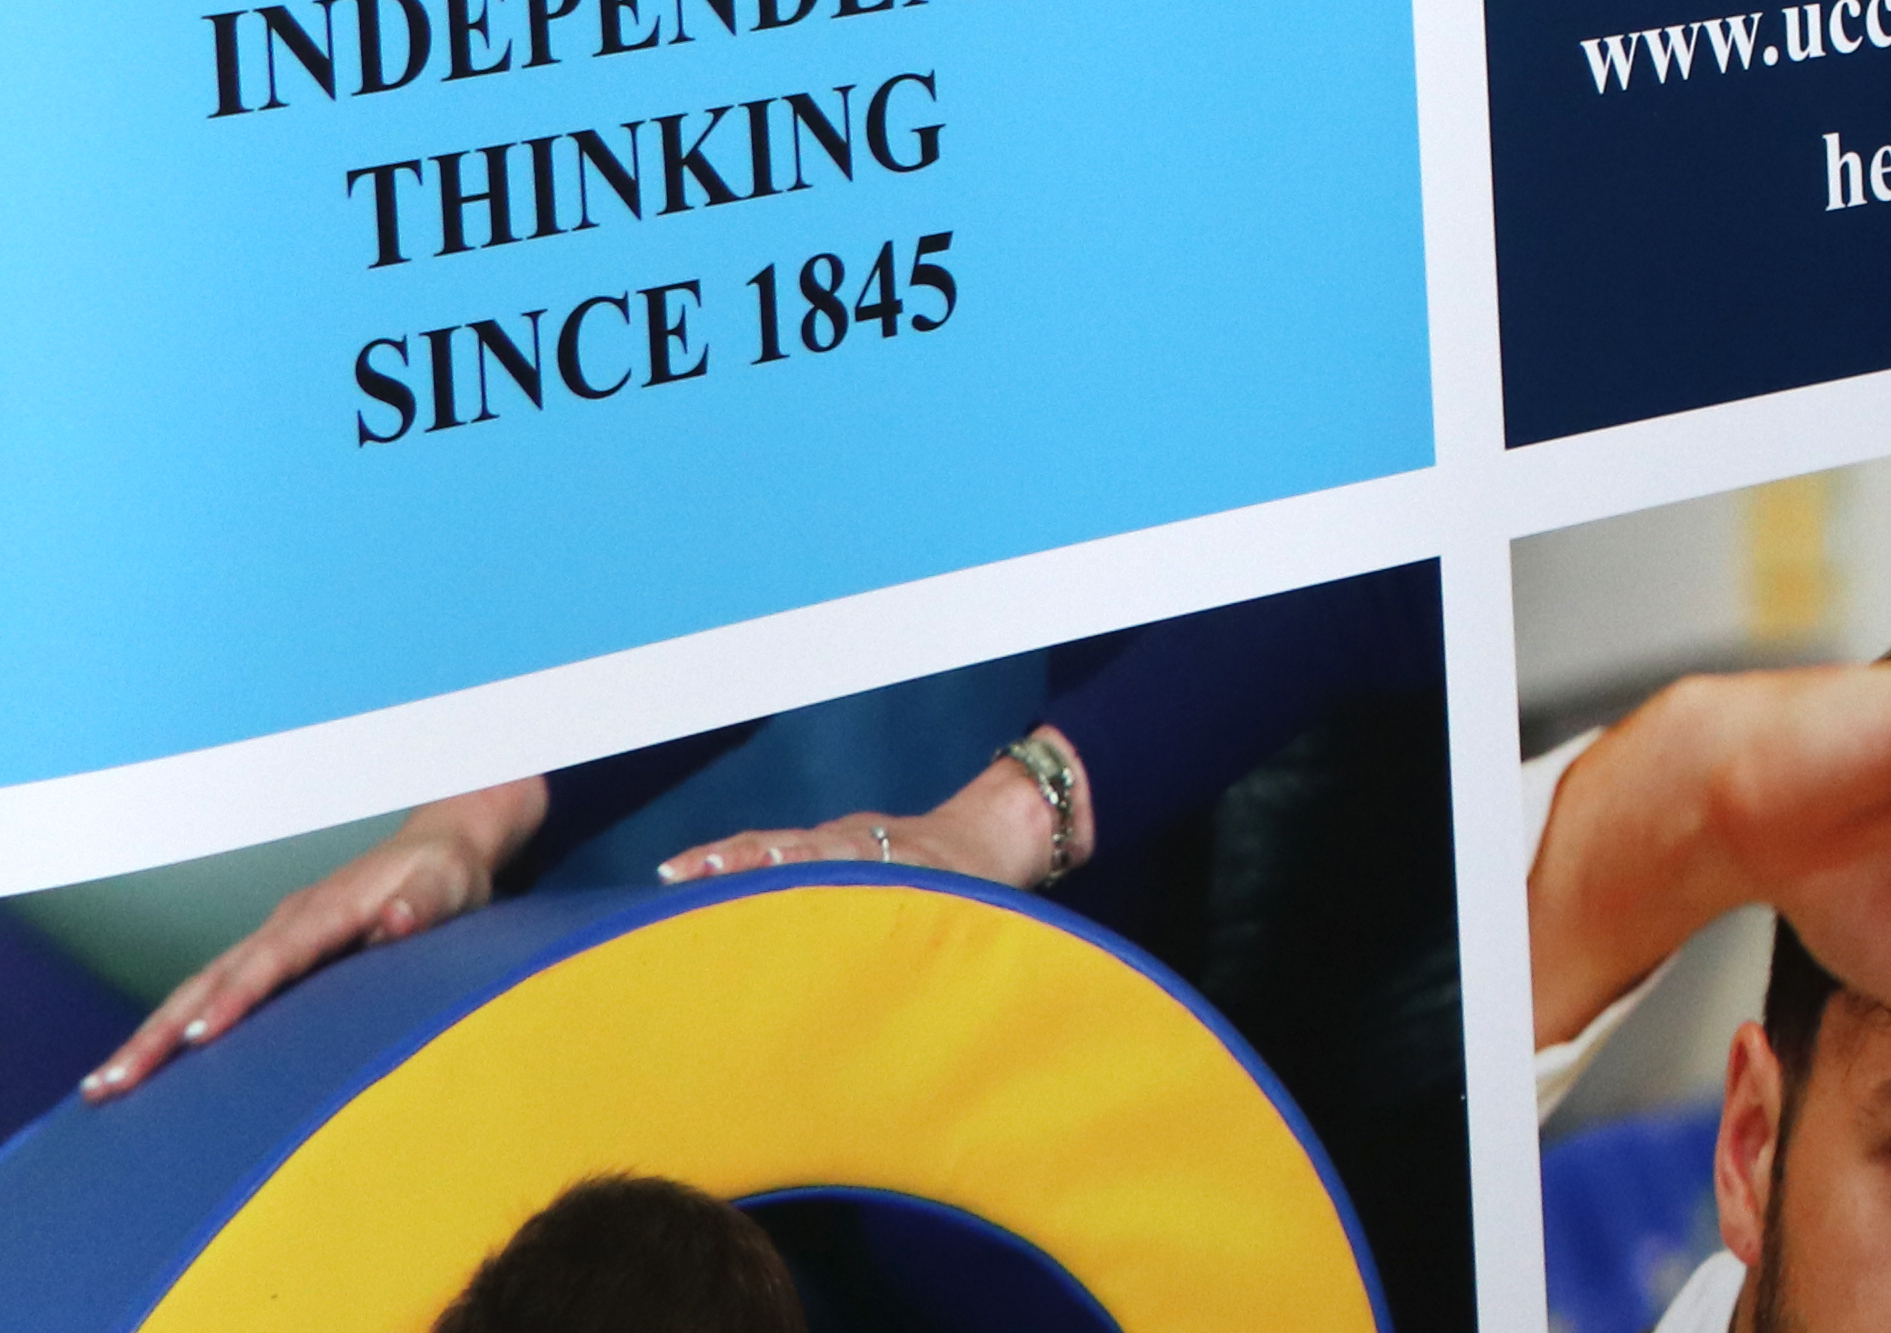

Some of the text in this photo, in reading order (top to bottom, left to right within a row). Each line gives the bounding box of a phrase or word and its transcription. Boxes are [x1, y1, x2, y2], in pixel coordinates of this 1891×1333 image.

[345, 69, 947, 271] THINKING
[352, 230, 960, 450] SINCE 1845
